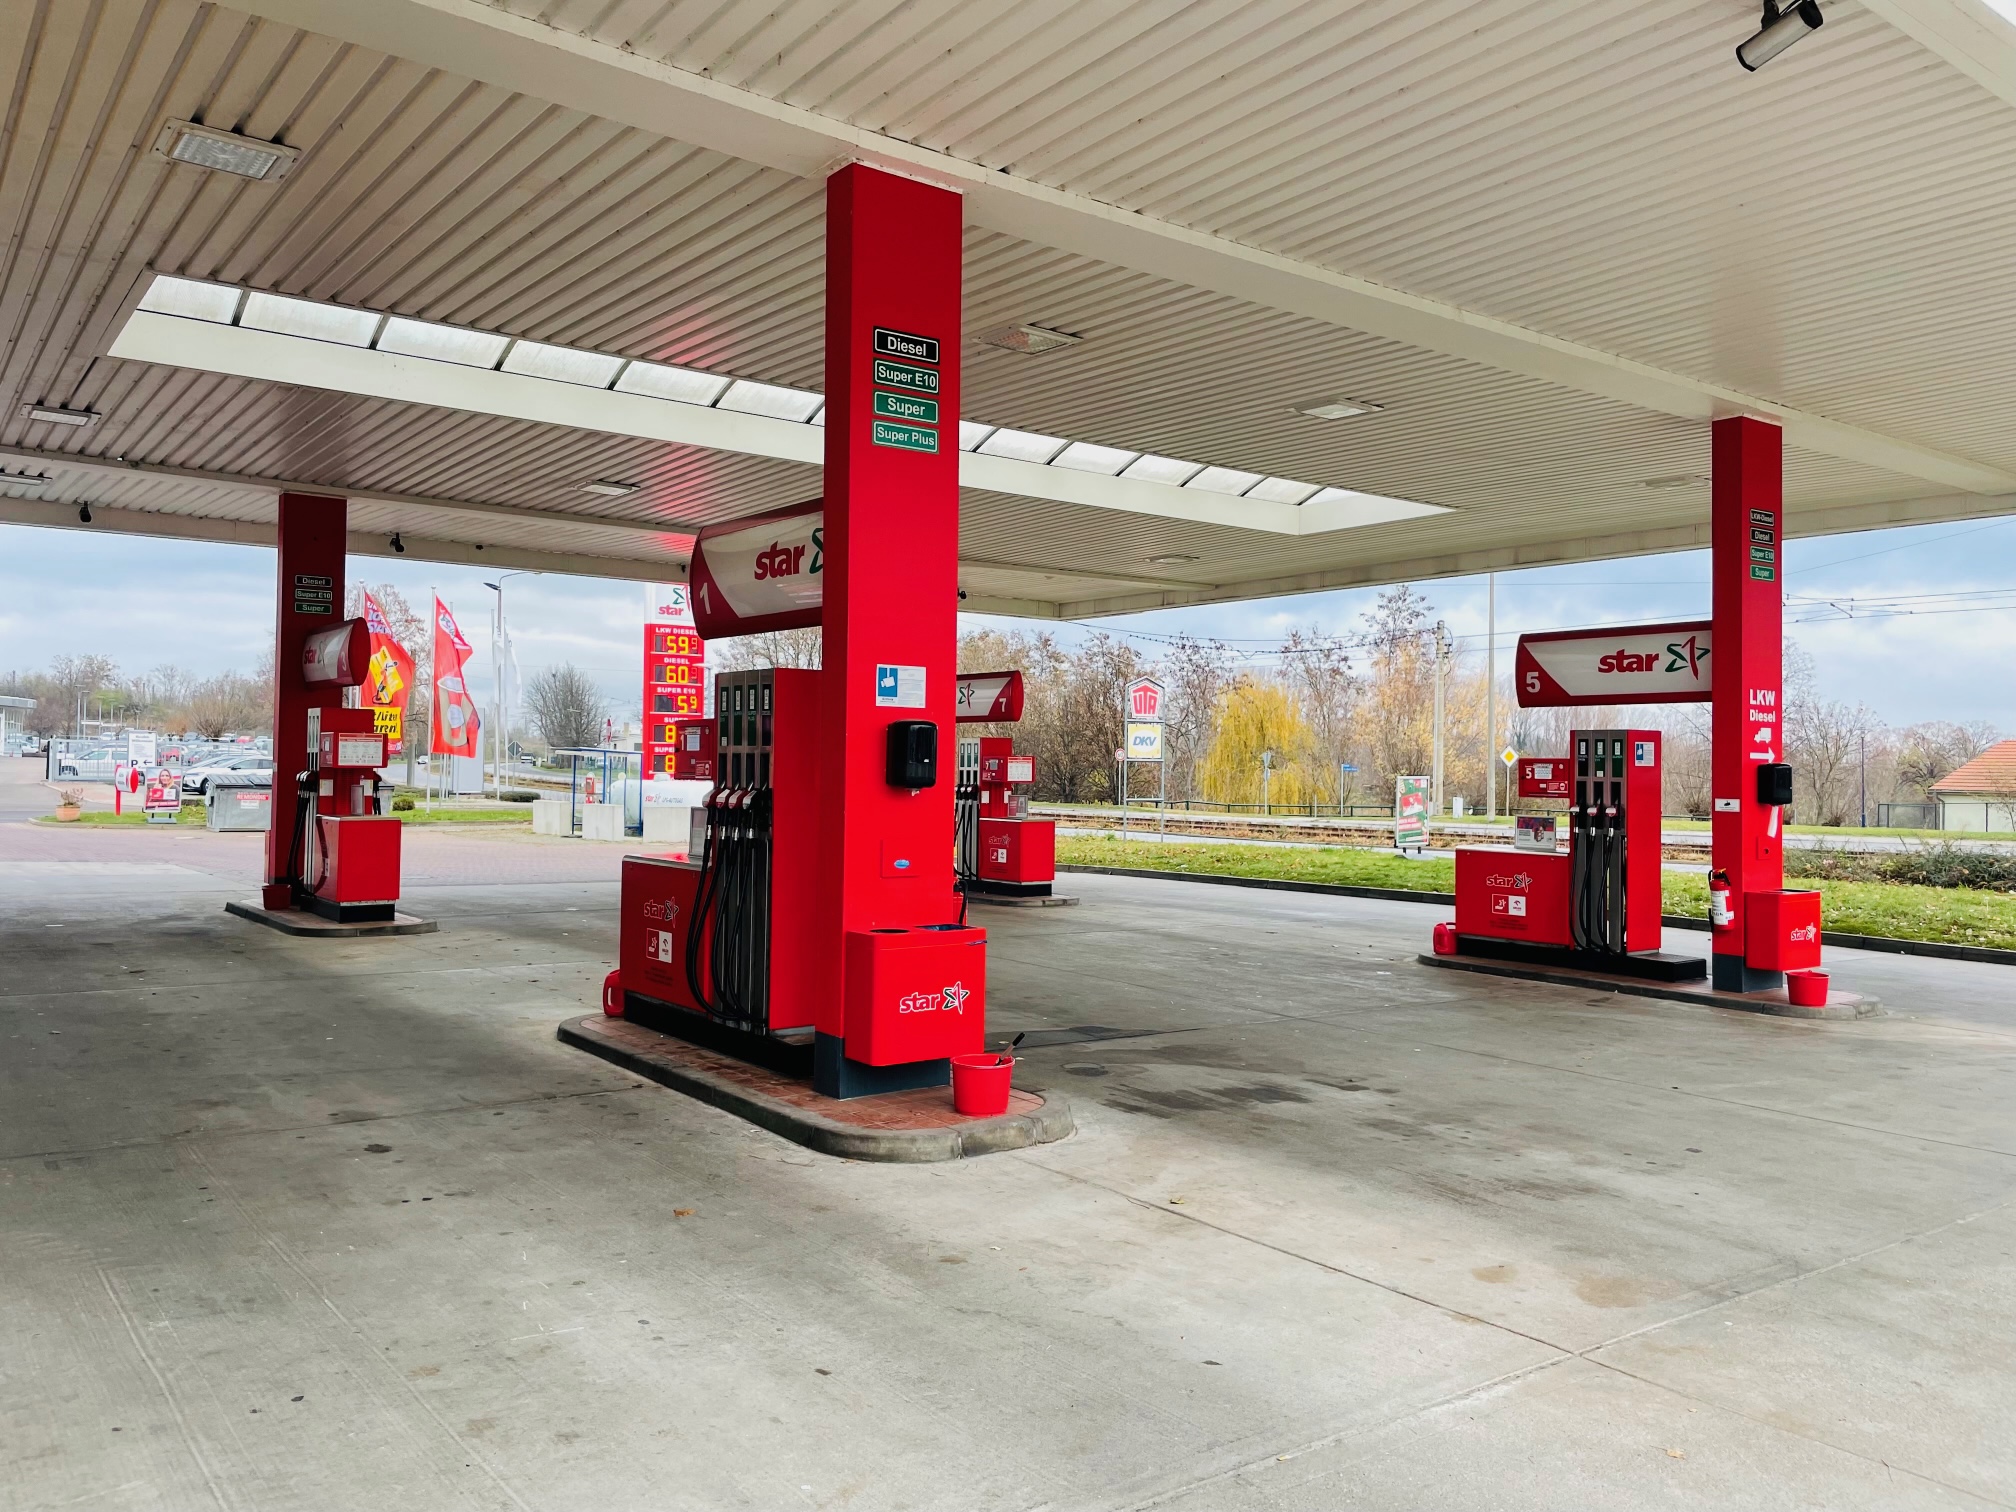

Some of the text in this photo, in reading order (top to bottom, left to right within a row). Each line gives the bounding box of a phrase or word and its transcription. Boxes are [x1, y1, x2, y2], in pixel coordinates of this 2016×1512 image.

[887, 336, 926, 356] Diesel
[878, 365, 936, 388] Super E10
[887, 397, 926, 416] Super
[877, 426, 935, 446] Super Plus
[1754, 531, 1770, 541] Diesel
[754, 540, 806, 580] star
[1751, 549, 1774, 560] Super E10
[1755, 567, 1770, 578] Super
[302, 577, 325, 585] Diesel
[297, 590, 317, 598] Super
[699, 582, 711, 614] 1
[302, 604, 325, 612] Super
[658, 604, 684, 616] star
[673, 628, 698, 636] DIESEL
[340, 651, 347, 672] 3
[663, 657, 690, 665] DIESEL
[1597, 649, 1660, 673] star
[1526, 671, 1541, 693] 5
[1132, 685, 1159, 715] UTA
[1749, 689, 1776, 706] LKW
[999, 698, 1007, 712] 7
[1749, 709, 1776, 723] Diesel
[1132, 736, 1157, 747] DKV
[131, 760, 139, 768] P
[1525, 767, 1532, 779] 5
[1486, 874, 1514, 888] star
[644, 899, 664, 919] star
[1790, 928, 1807, 941] star
[900, 992, 940, 1014] star
